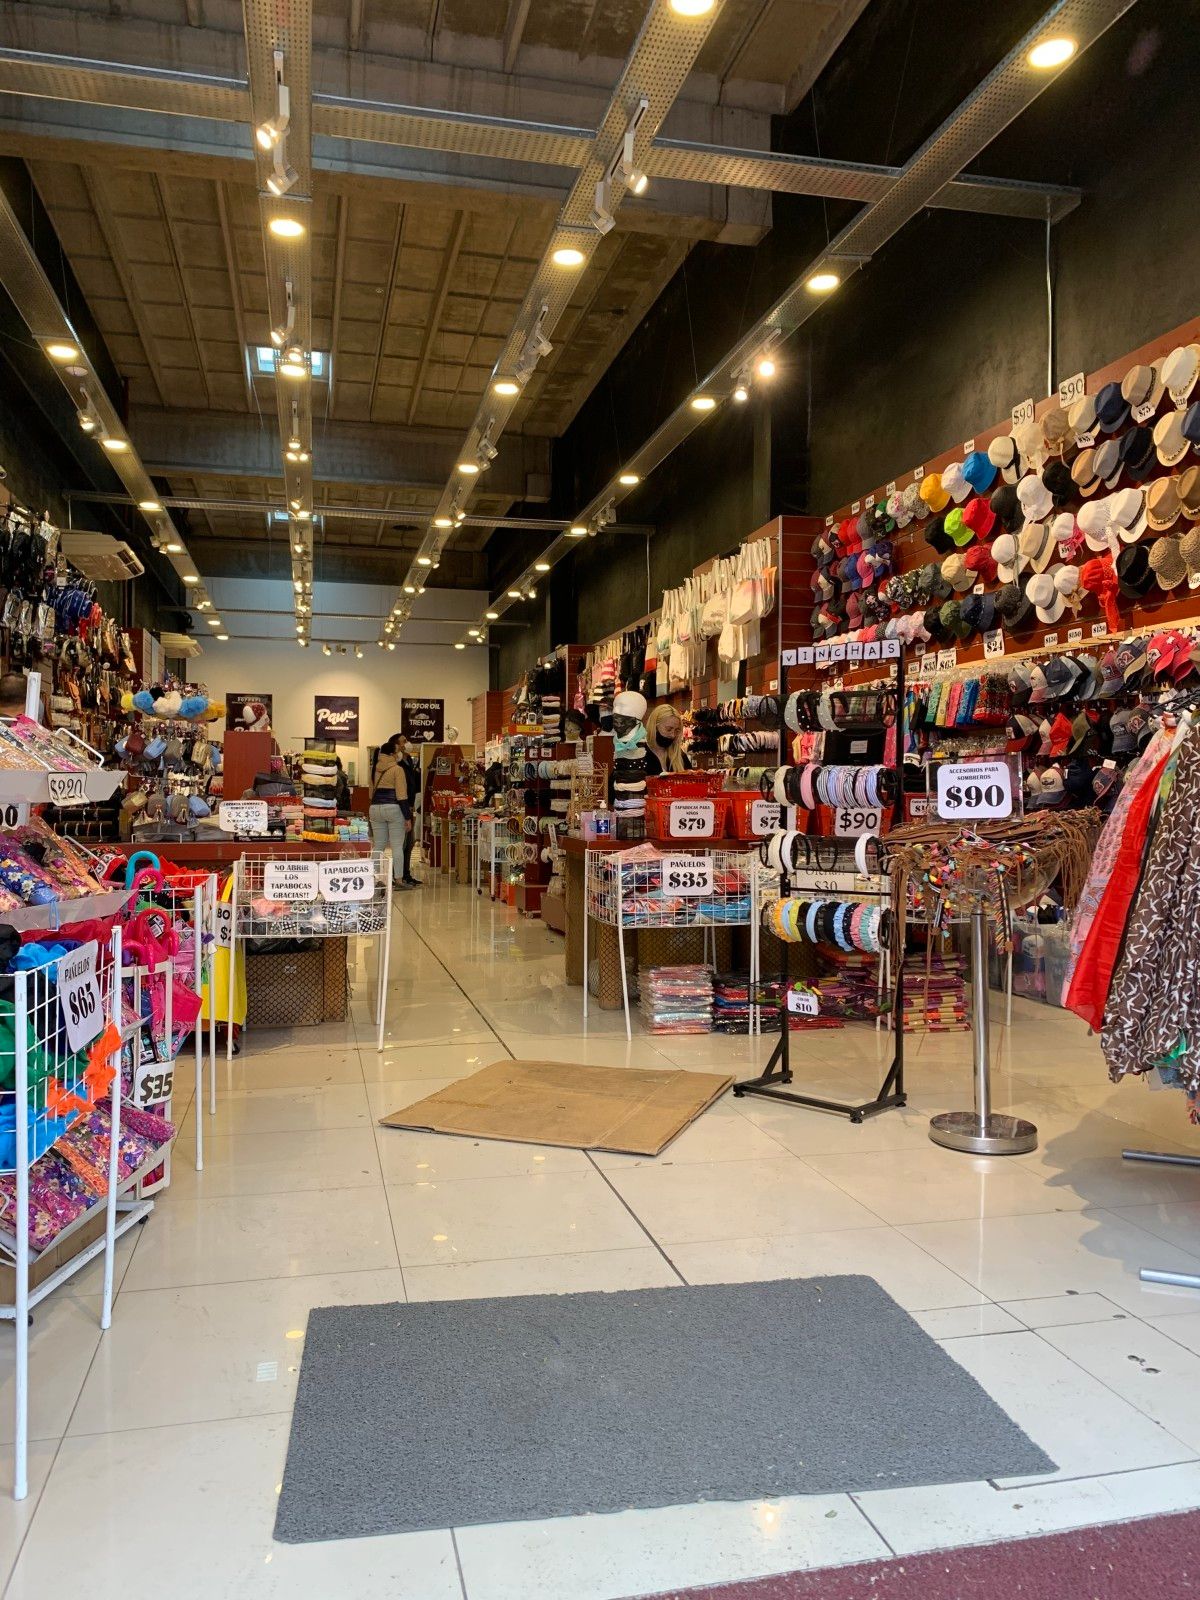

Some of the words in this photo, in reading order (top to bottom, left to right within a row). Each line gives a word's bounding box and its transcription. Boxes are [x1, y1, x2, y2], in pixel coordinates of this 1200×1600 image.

[1061, 379, 1083, 402] $90
[1013, 404, 1033, 425] $90
[986, 641, 1003, 652] $24
[50, 778, 83, 801] $220
[945, 784, 1005, 811] $90
[678, 817, 706, 832] $79
[760, 815, 781, 830] $7
[839, 807, 878, 832] $90
[323, 866, 369, 875] TAPABOCAS
[670, 859, 706, 868] PAÑUELOS
[329, 876, 365, 894] $79
[668, 871, 708, 889] $35
[64, 956, 91, 982] PAÑUELOS
[69, 981, 96, 1027] $65
[795, 1003, 812, 1012] $10
[140, 1072, 173, 1104] $35
